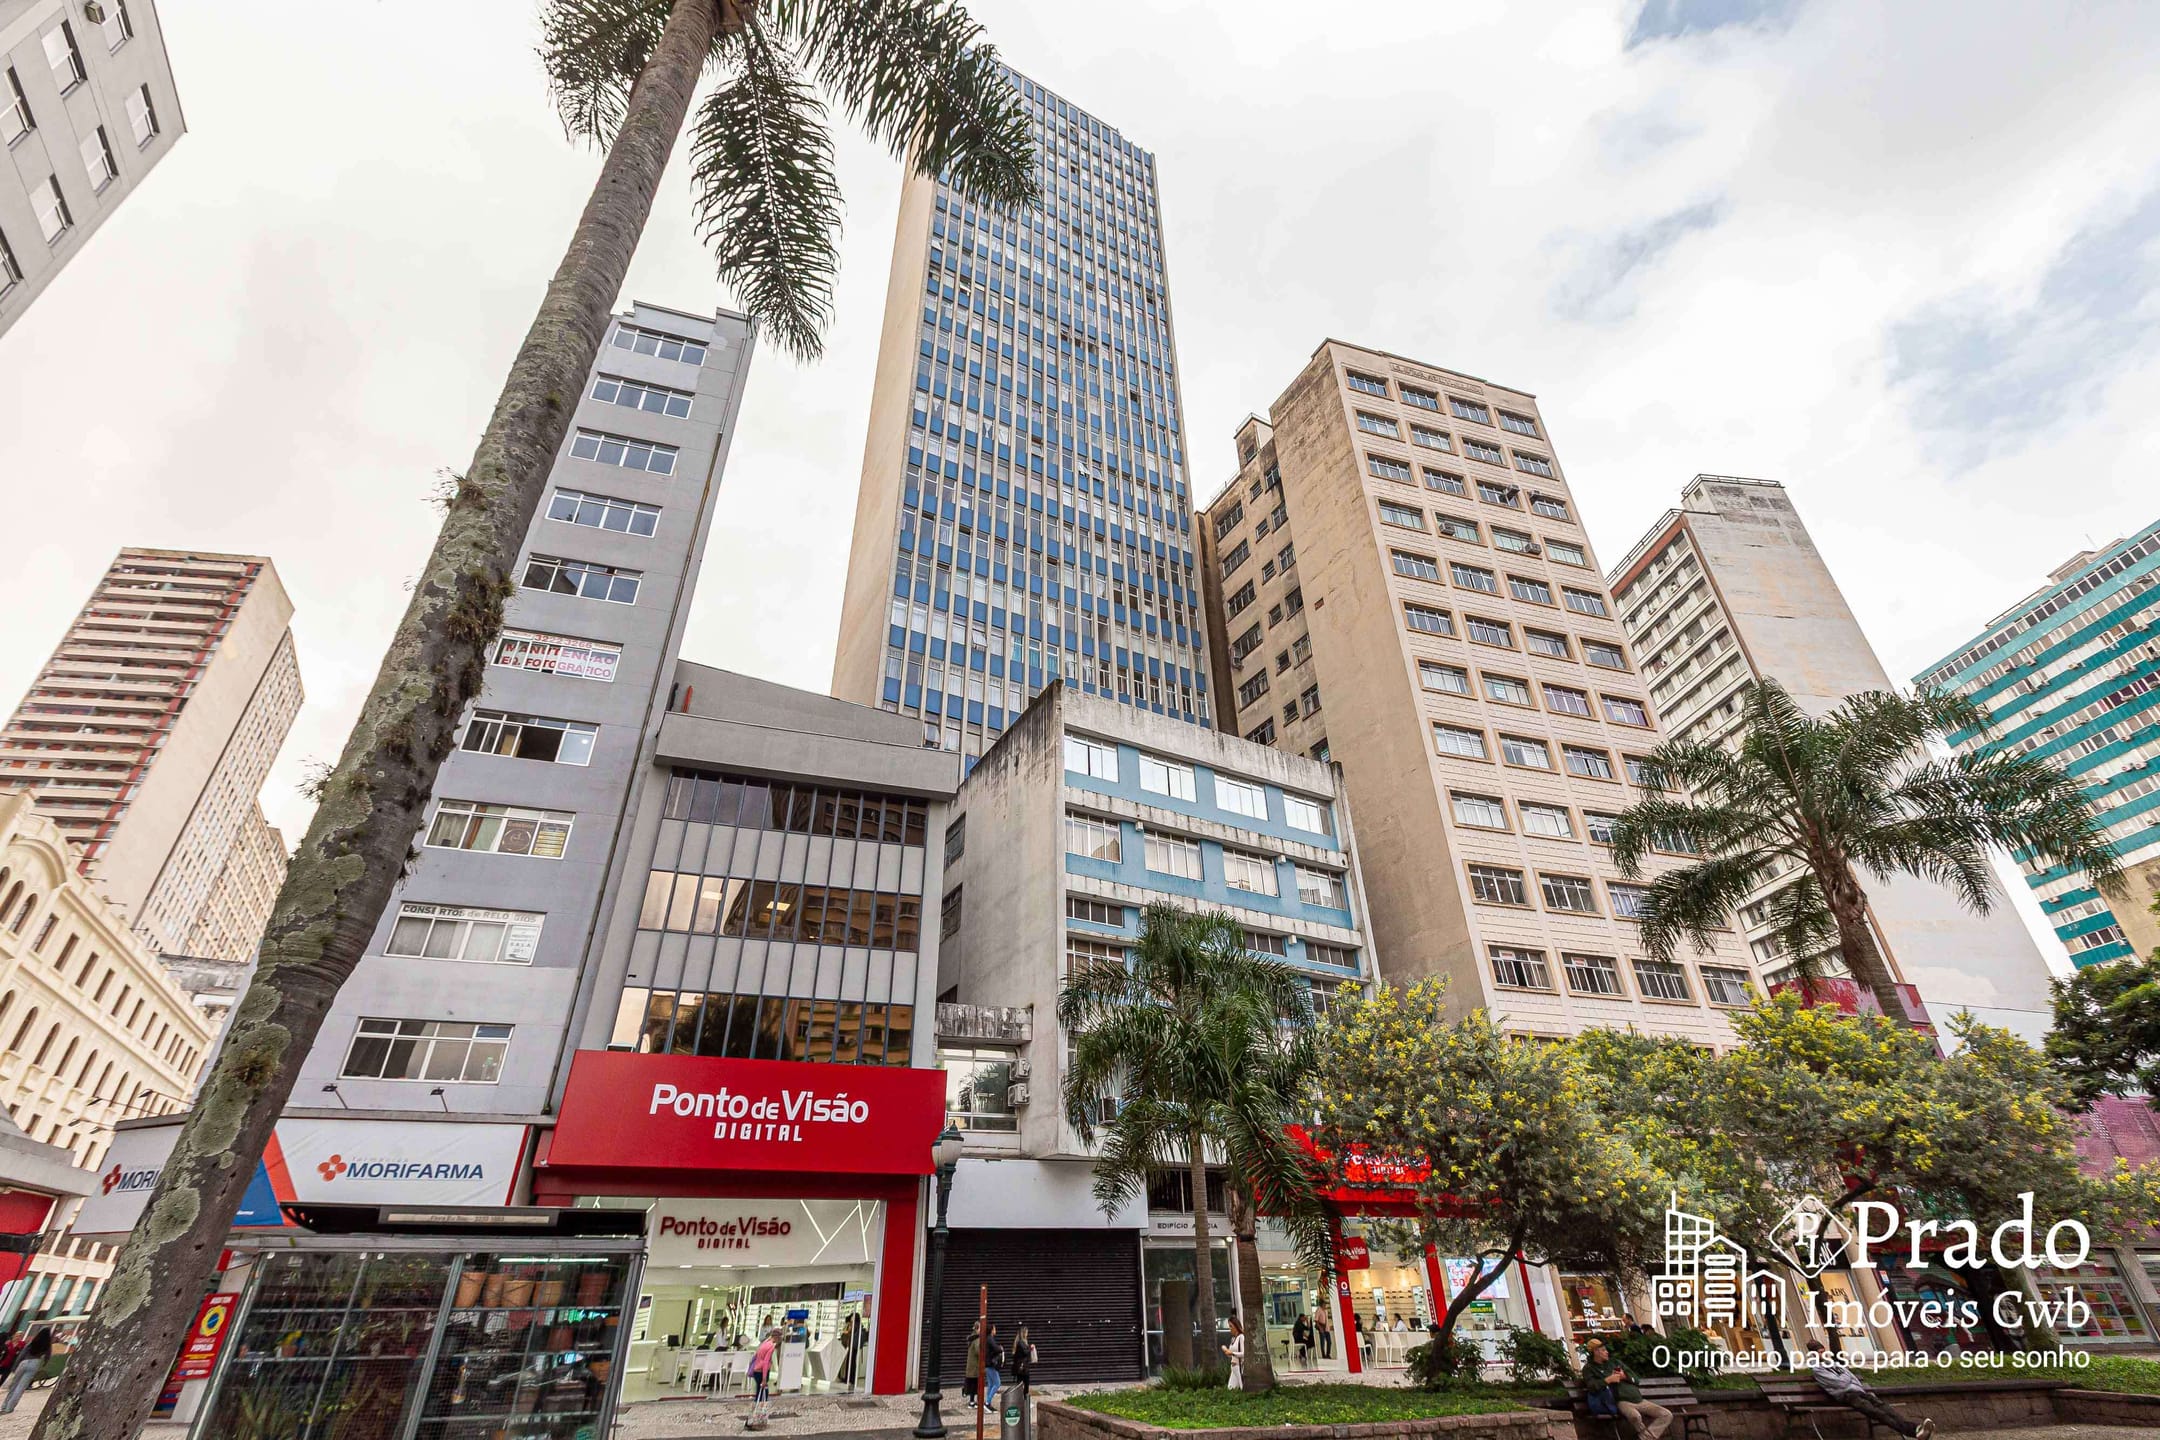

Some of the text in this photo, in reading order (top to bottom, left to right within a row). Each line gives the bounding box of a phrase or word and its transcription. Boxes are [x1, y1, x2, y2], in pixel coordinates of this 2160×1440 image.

[649, 1083, 869, 1124] Ponto de Visão
[713, 1122, 803, 1142] DIGITAL
[117, 1170, 160, 1190] MORI
[346, 1162, 484, 1179] MORIFARMA
[660, 1216, 791, 1236] Ponto de Visão
[697, 1238, 751, 1249] DIGITAL
